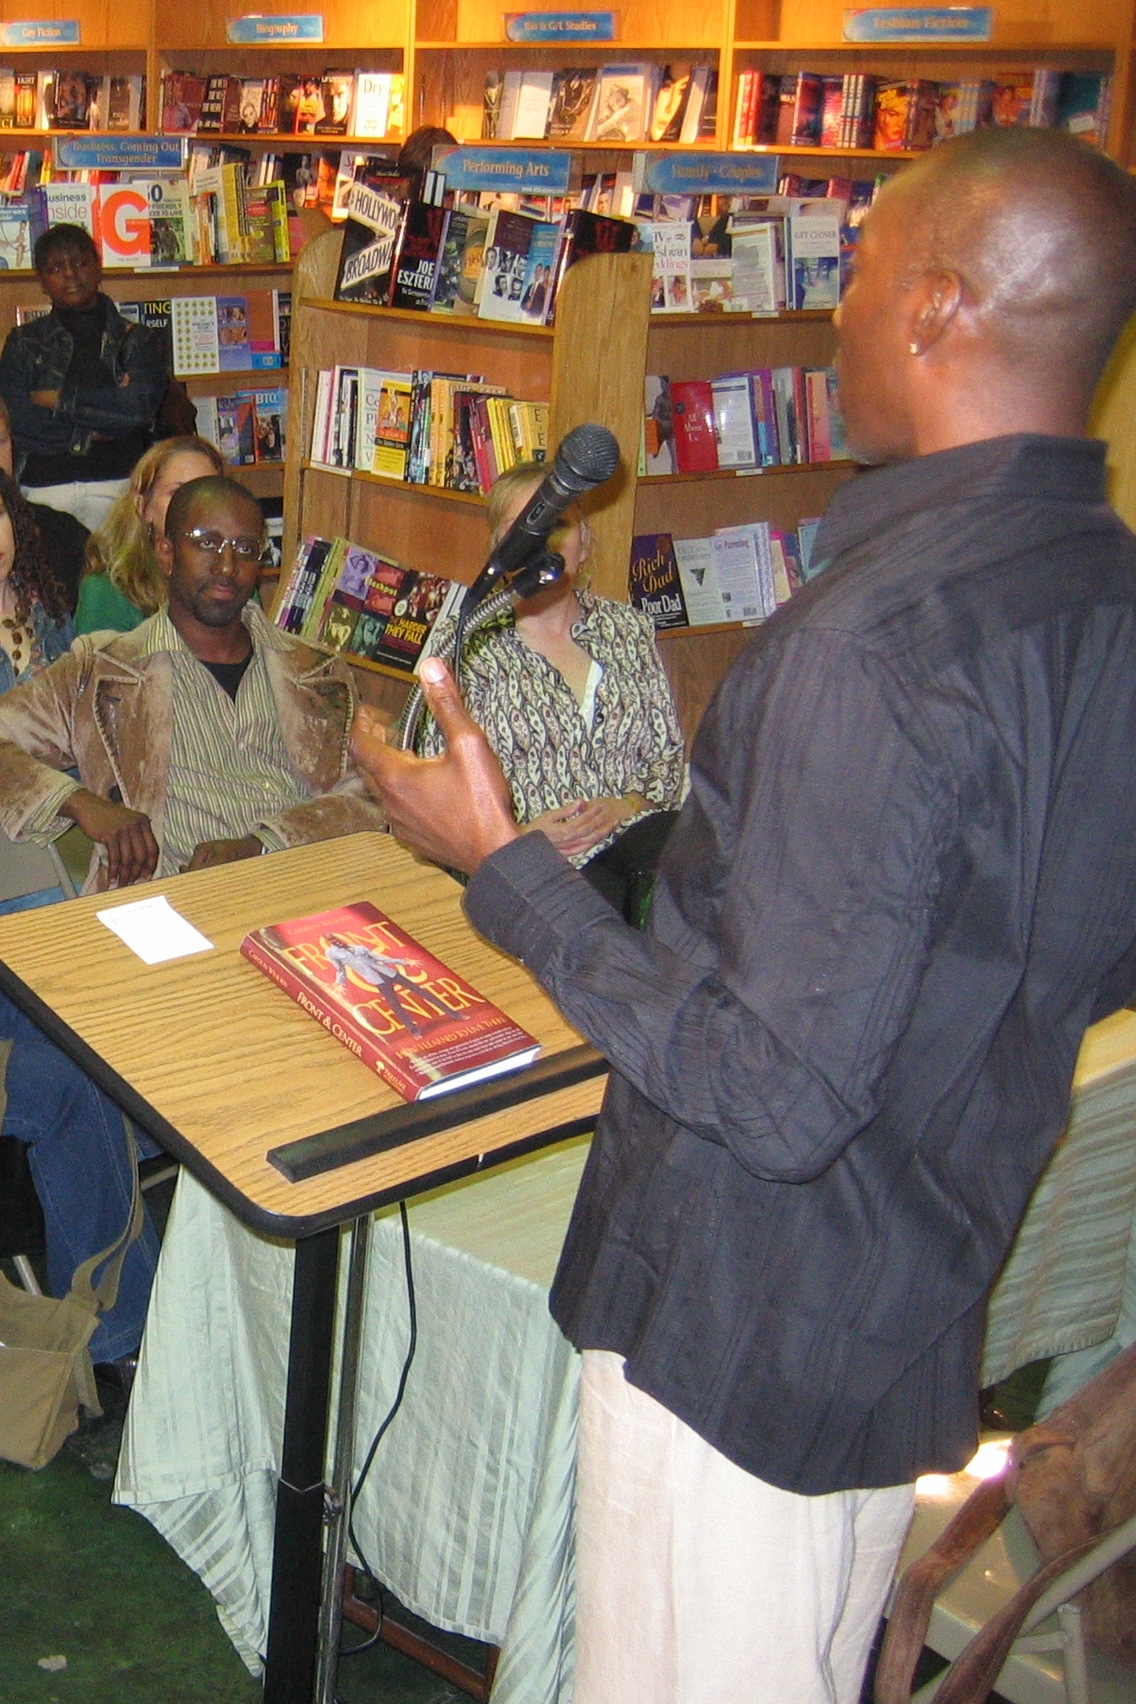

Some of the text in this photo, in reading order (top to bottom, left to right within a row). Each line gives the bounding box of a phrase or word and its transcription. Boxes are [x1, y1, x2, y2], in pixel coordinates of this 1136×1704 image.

[37, 26, 62, 37] Fiction
[255, 22, 298, 35] Biography
[566, 20, 597, 31] Studies
[364, 79, 383, 97] Dry
[119, 142, 159, 154] Coming
[161, 141, 180, 152] Out
[95, 153, 157, 165] Transgender
[463, 159, 550, 178] Performing Arts
[48, 203, 88, 219] nside
[101, 189, 153, 256] G
[344, 241, 393, 284] BROADWA
[417, 258, 435, 277] JOE
[632, 549, 666, 580] Rich
[641, 565, 674, 594] Dad
[640, 594, 683, 615] Poor Dad
[384, 623, 424, 646] THEY FALL
[398, 618, 428, 633] HARDER
[282, 920, 406, 976] FRONT
[351, 976, 487, 1036] CENTER
[296, 990, 364, 1058] FRONT & CENTER
